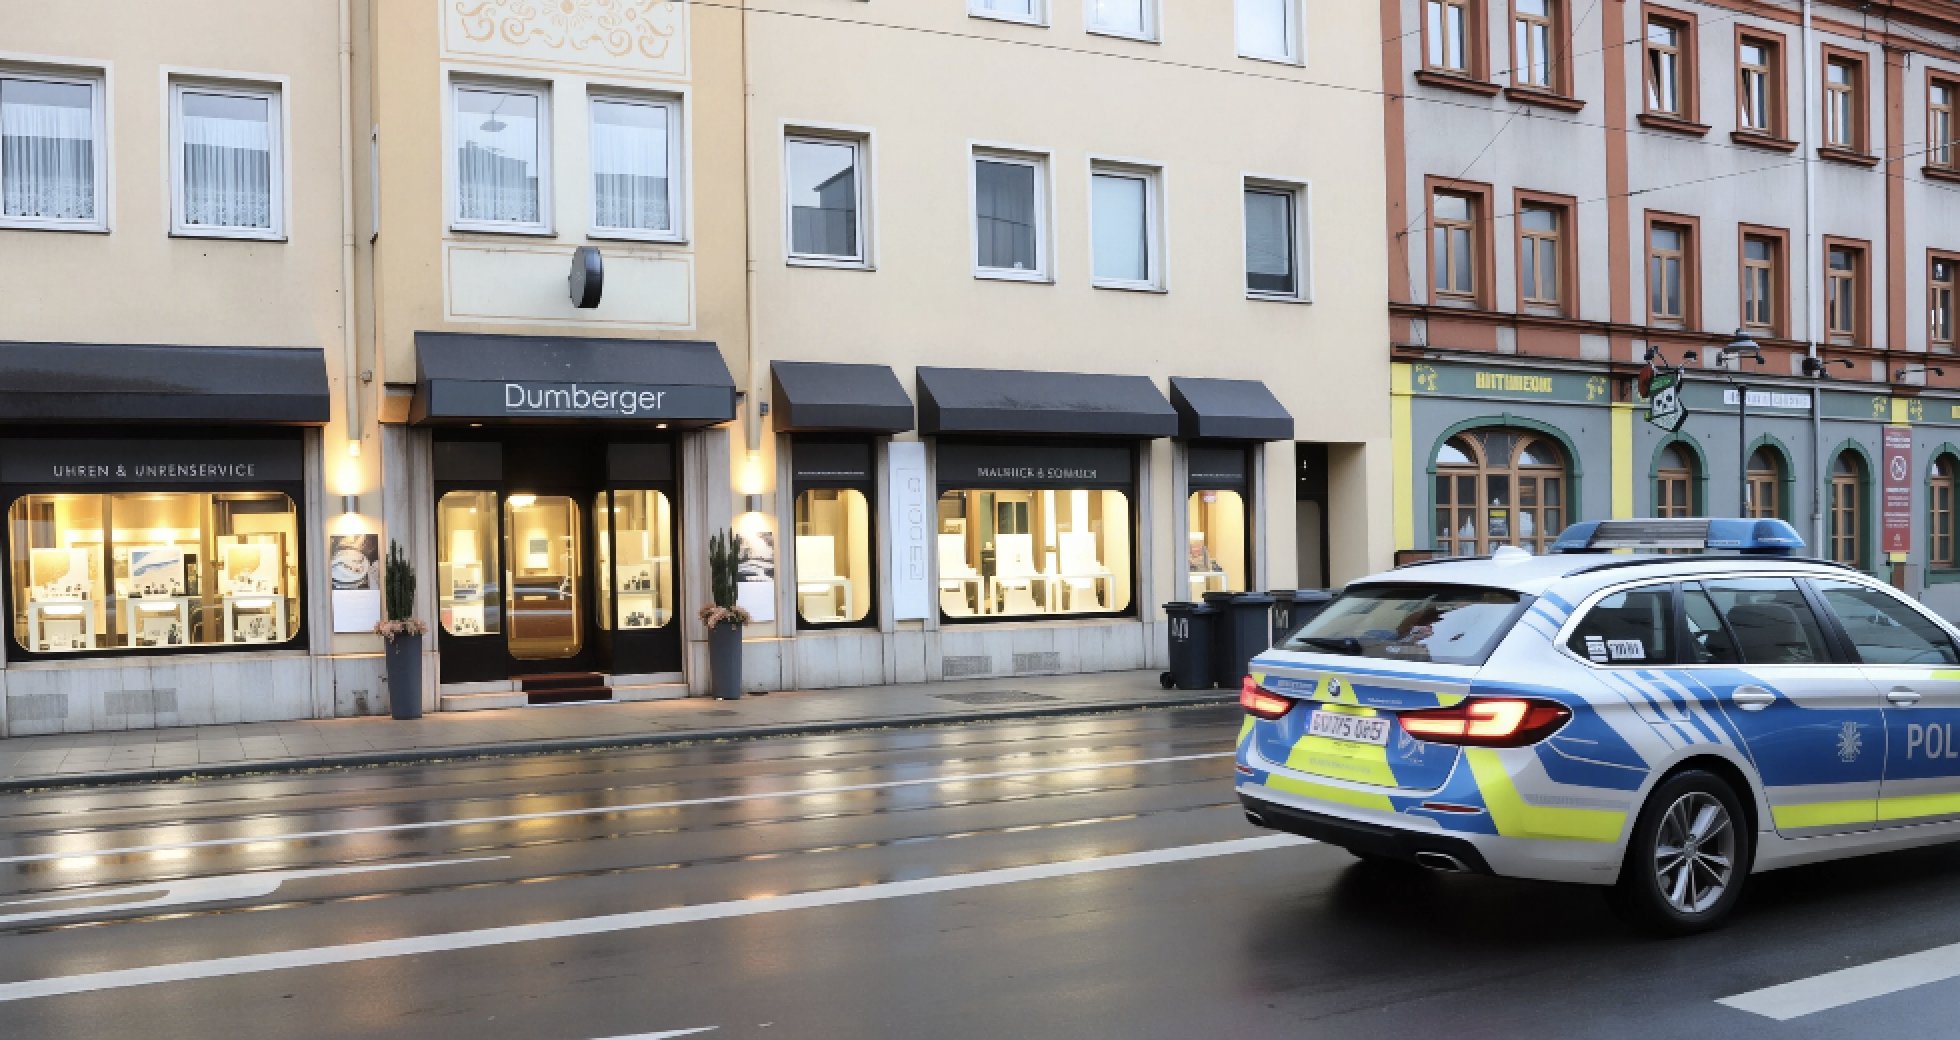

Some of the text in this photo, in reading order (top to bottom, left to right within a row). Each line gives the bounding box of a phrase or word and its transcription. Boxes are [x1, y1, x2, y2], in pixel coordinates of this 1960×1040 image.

[505, 383, 667, 415] Dumberger
[53, 464, 109, 478] UHREN
[115, 463, 127, 477] &
[1907, 723, 1959, 759] POL
